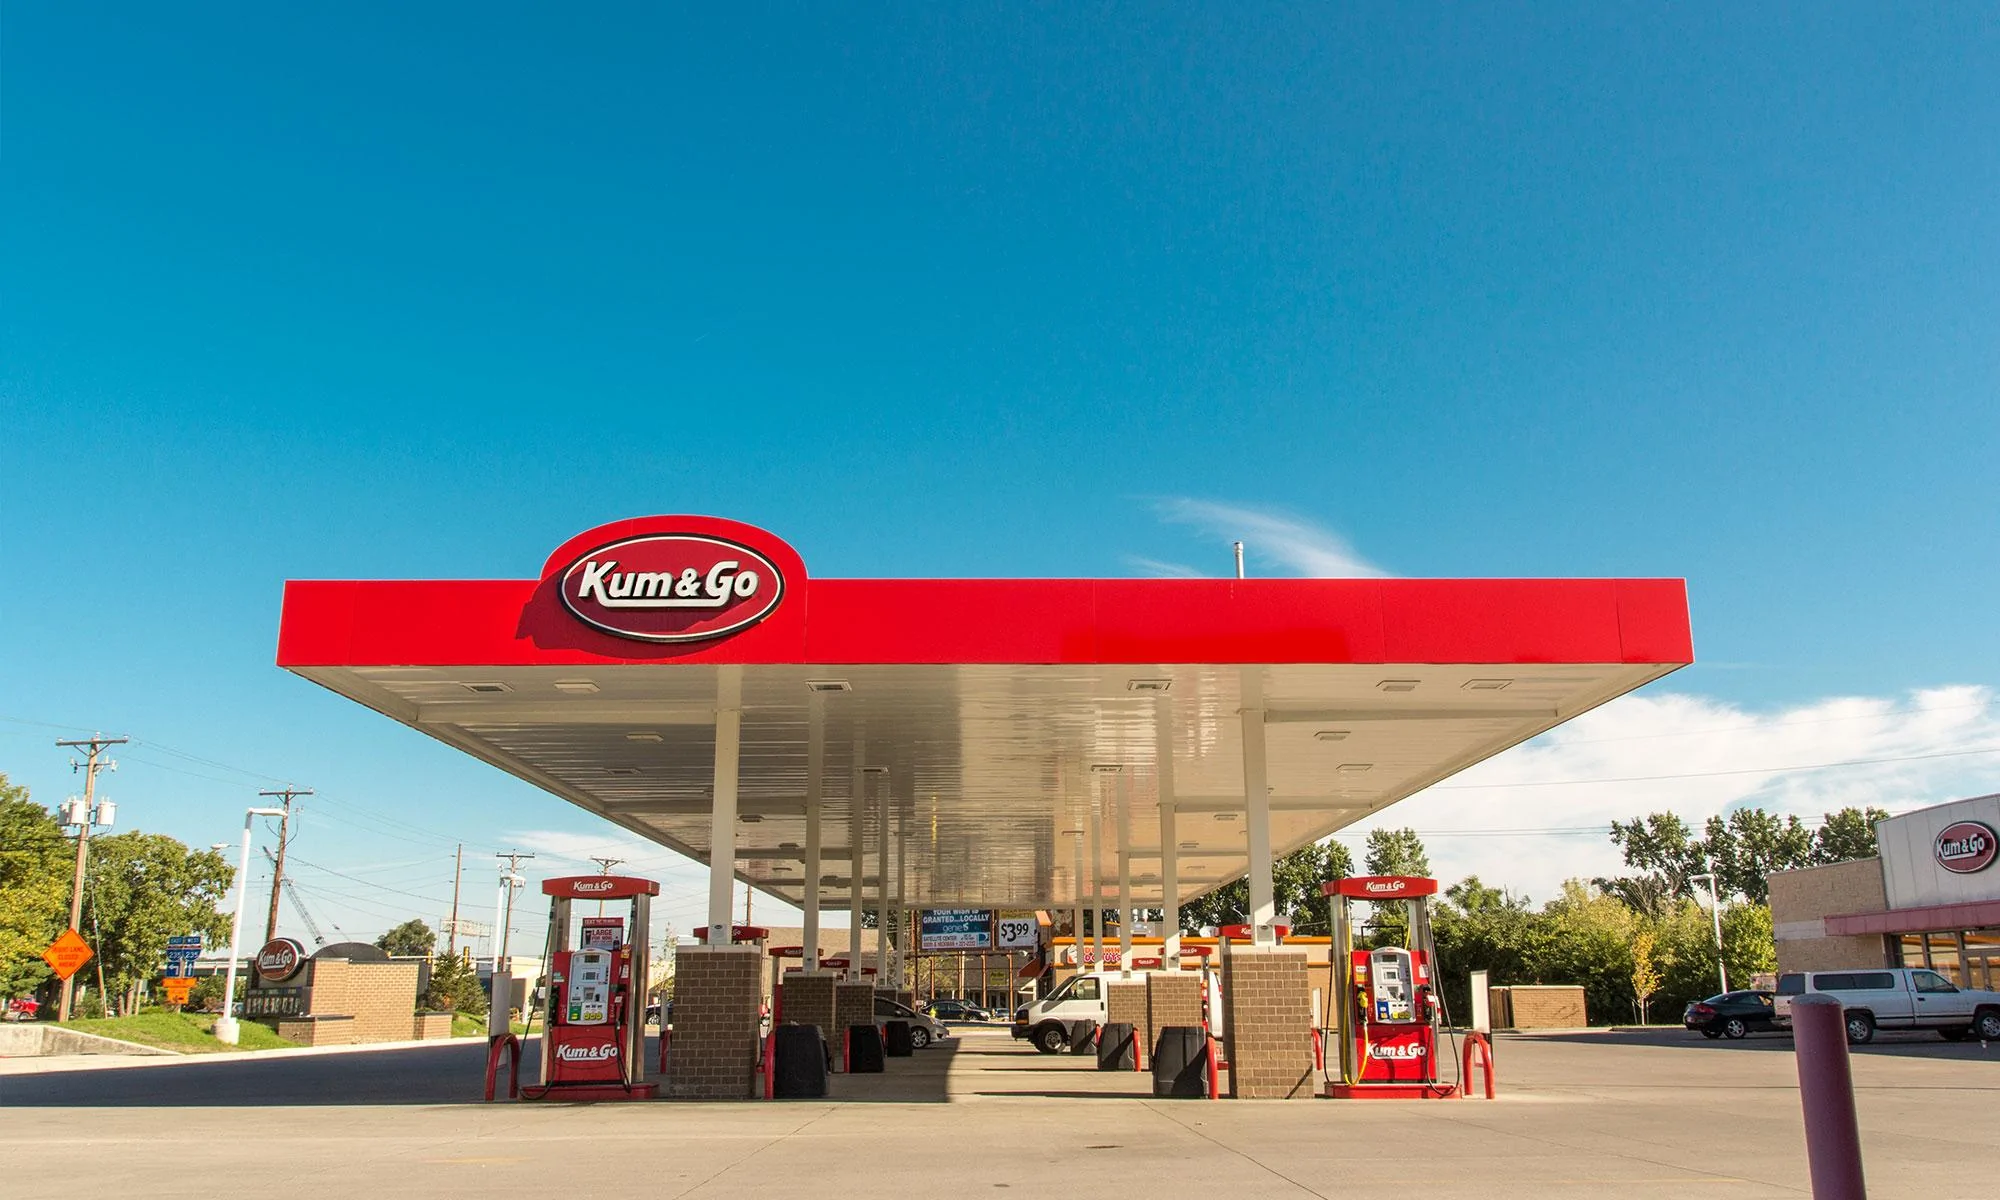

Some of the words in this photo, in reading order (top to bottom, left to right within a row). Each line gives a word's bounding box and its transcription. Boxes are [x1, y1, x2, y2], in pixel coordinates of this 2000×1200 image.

[573, 881, 593, 891] Kum
[600, 880, 613, 891] Go
[1366, 881, 1386, 892] Kum
[1393, 880, 1405, 891] Go
[556, 1044, 587, 1061] Kum
[589, 1047, 598, 1057] &
[600, 1044, 618, 1061] Go
[1367, 1042, 1396, 1059] Kum
[1397, 1045, 1406, 1056] &
[1407, 1042, 1426, 1059] Go
